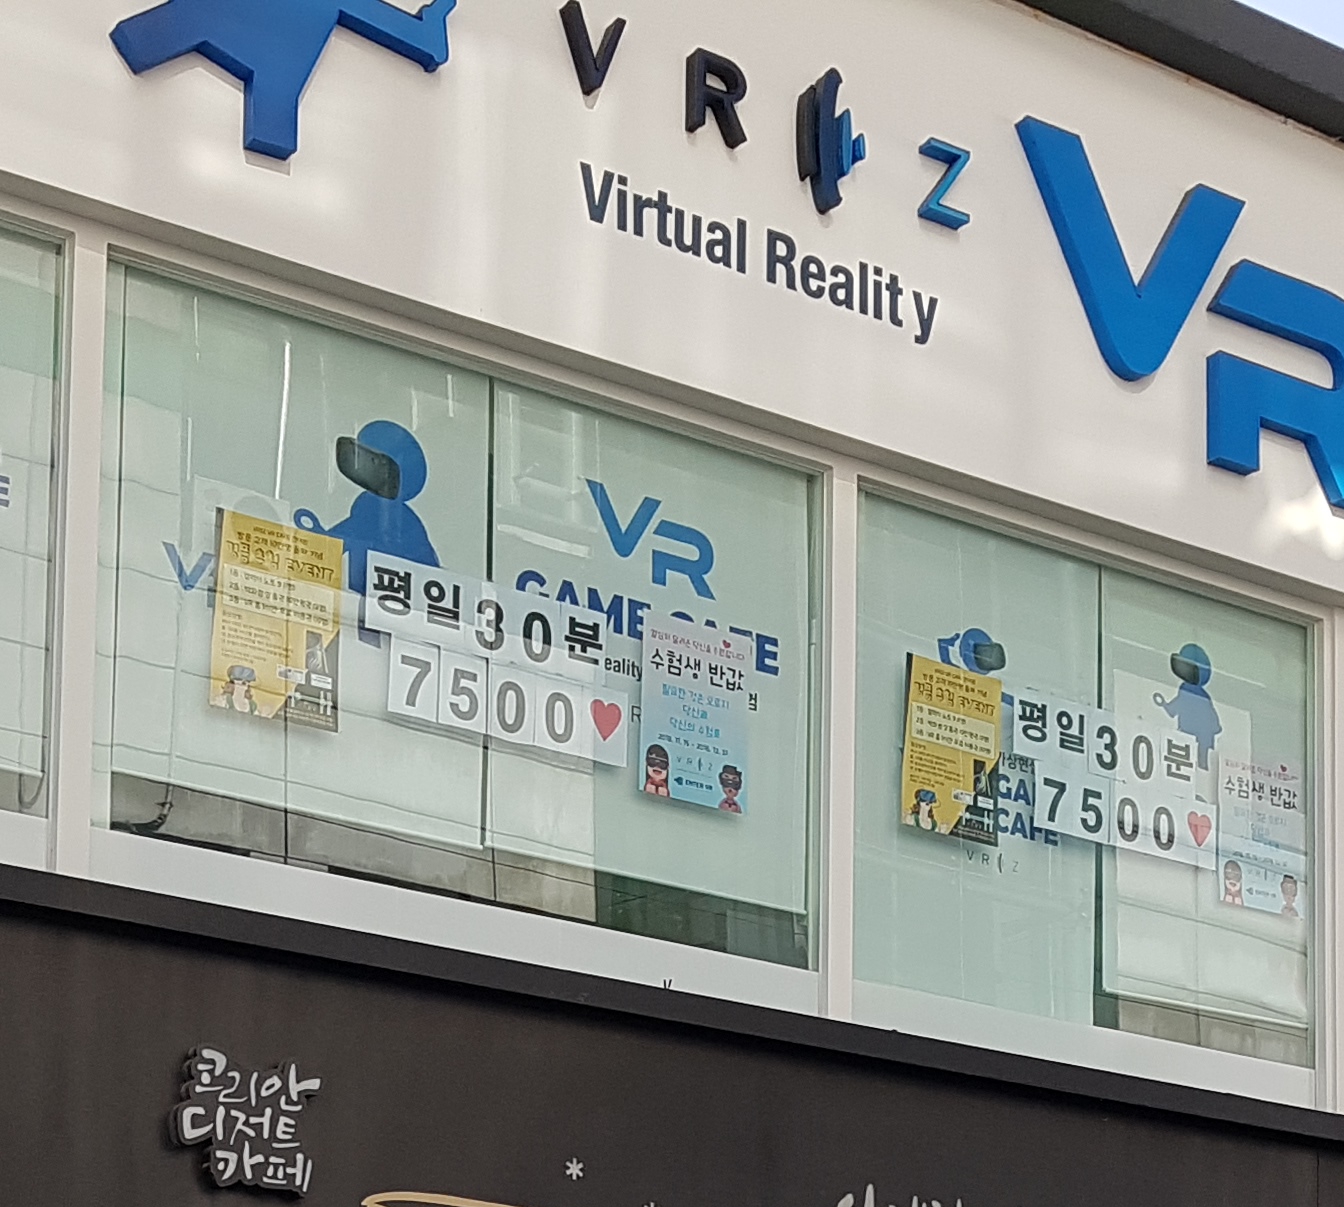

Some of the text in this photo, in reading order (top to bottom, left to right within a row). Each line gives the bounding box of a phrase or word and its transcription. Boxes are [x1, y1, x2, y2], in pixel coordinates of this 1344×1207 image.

[578, 160, 940, 346] Virtual Reality
[285, 557, 334, 581] EVENT
[585, 478, 716, 601] VR
[372, 564, 462, 631] 평일
[399, 654, 574, 744] 7500
[650, 648, 745, 691] 수험생 반값
[1018, 698, 1085, 754] 평일
[1043, 777, 1176, 851] 7500
[1224, 775, 1298, 810] 수험생 반값
[194, 1047, 321, 1111] 코리안
[181, 1106, 301, 1148] 디저트
[214, 1142, 312, 1193] 카페
